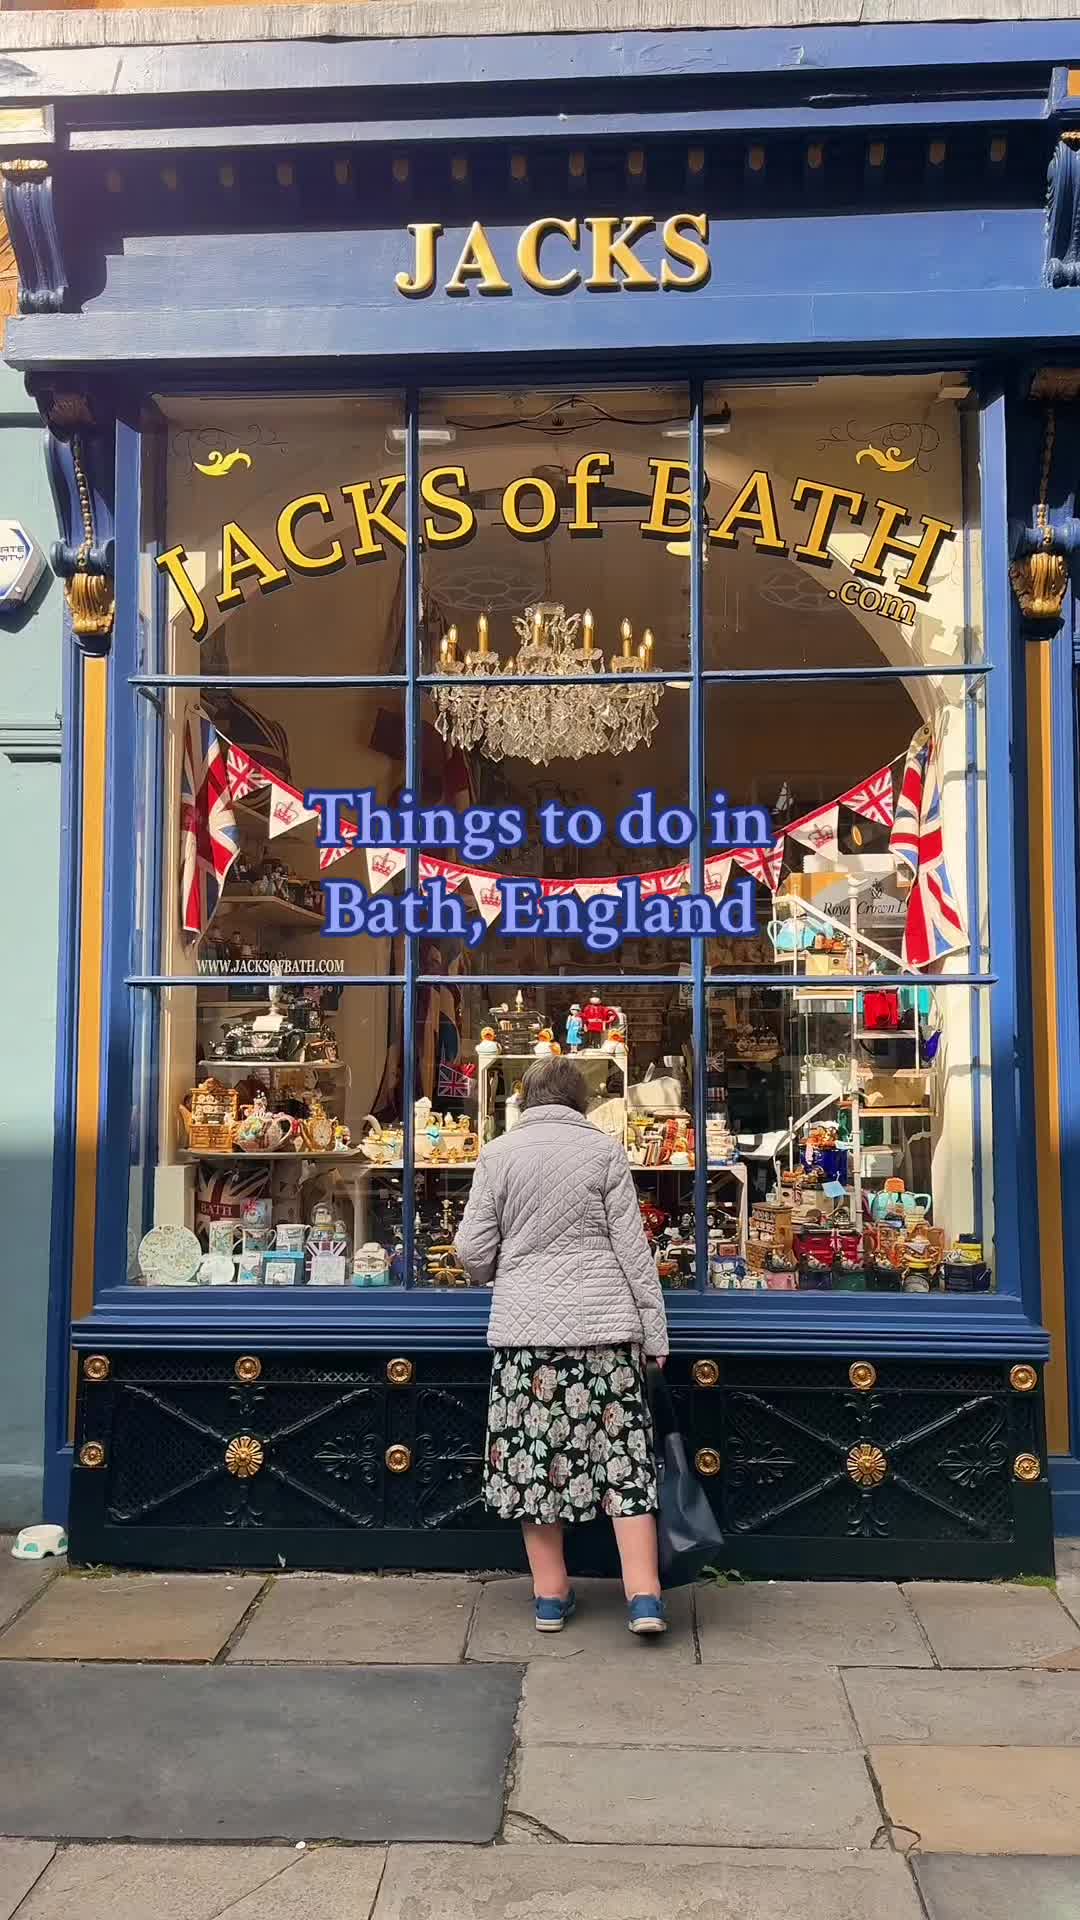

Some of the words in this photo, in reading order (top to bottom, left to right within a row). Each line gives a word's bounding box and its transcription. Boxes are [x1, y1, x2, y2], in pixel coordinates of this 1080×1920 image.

[395, 213, 712, 299] JACKS
[156, 465, 477, 642] JACKS
[502, 452, 614, 541] of
[640, 456, 957, 601] BATH
[827, 579, 917, 627] .com
[822, 901, 851, 917] Roya
[196, 959, 345, 973] WWW.JACKSOFBATH.COM
[201, 1202, 232, 1216] BATH
